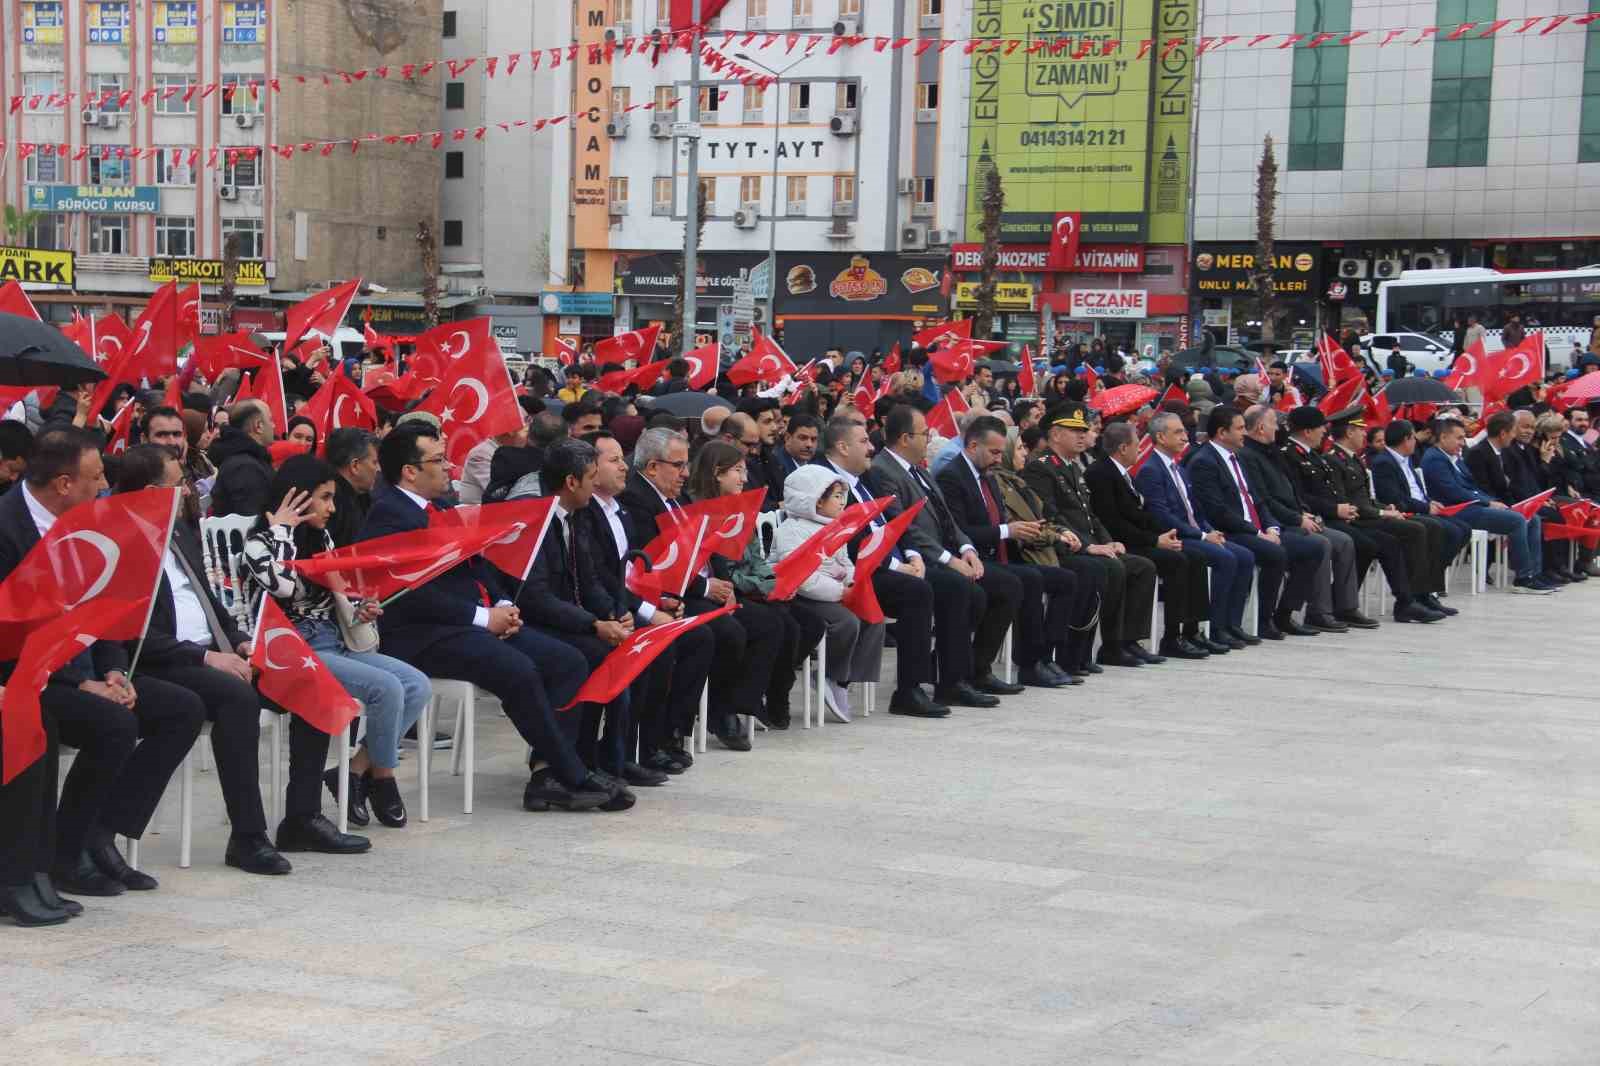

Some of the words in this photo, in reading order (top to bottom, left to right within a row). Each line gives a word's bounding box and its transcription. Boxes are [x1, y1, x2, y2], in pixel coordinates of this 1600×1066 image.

[57, 198, 108, 211] SÜRÜCÜ
[113, 200, 156, 212] KURSU
[1082, 249, 1138, 268] VİTAMİN
[1216, 254, 1292, 269] MERAN
[1199, 280, 1230, 290] UNLU
[1074, 293, 1143, 308] ECZANE
